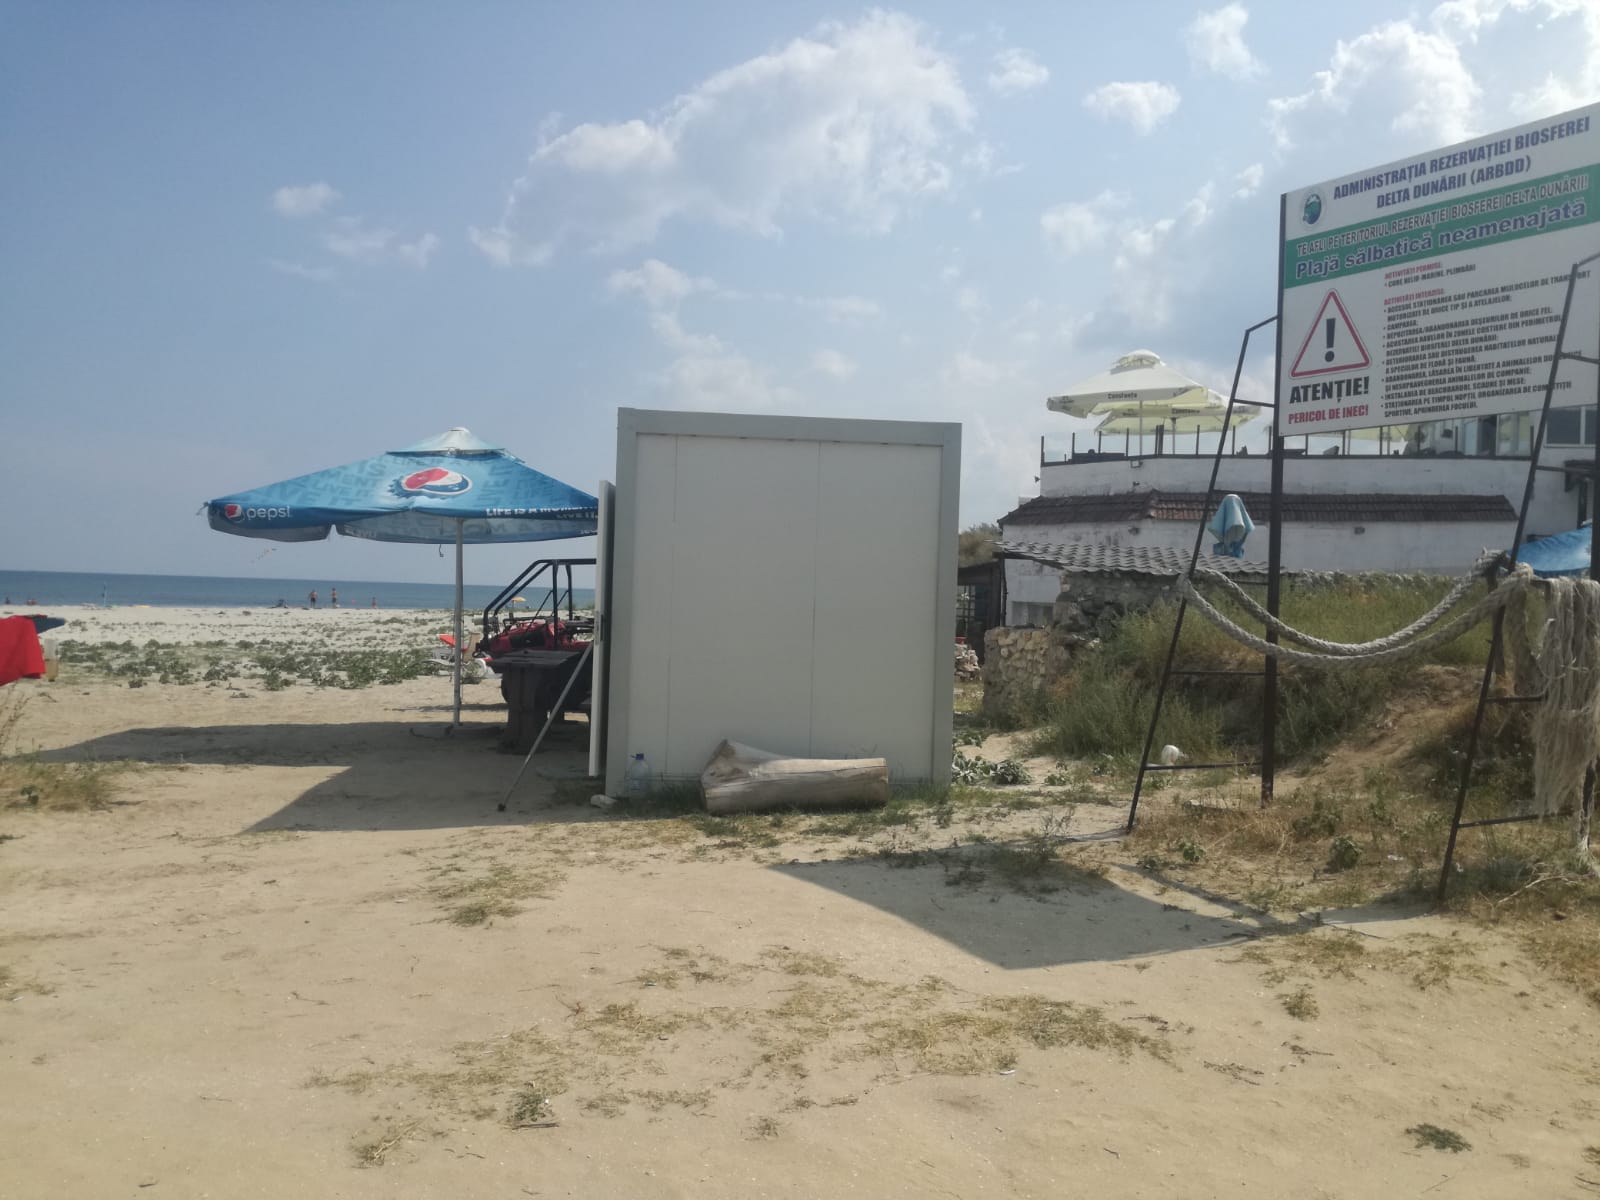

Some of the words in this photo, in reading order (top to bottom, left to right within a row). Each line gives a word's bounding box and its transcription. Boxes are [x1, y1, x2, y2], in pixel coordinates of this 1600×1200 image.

[1334, 161, 1426, 200] ADMINISTRAȚIA
[1430, 138, 1511, 174] REZERVAȚIEI
[1515, 116, 1590, 151] BIOSFEREI
[1377, 187, 1410, 209] DELTA
[1413, 172, 1466, 199] DUNĂRII
[1470, 155, 1532, 185] (ARBDD)
[1296, 256, 1339, 278] Plajă
[1345, 232, 1432, 267] sălbatică
[1439, 197, 1586, 245] neamenajată
[1298, 243, 1307, 257] TE
[1308, 240, 1326, 254] AFLI
[1328, 238, 1340, 249] PE
[1341, 223, 1389, 246] TERITORIUL
[1391, 209, 1449, 233] REZERVAȚIEI
[1452, 199, 1504, 219] BIOSFEREI
[1505, 187, 1537, 207] DELTA
[1541, 278, 1549, 286] DE
[1288, 410, 1326, 424] PERICOL
[1329, 408, 1341, 419] DE
[1343, 405, 1368, 418] INEC!
[1289, 376, 1369, 404] ATENȚIE!
